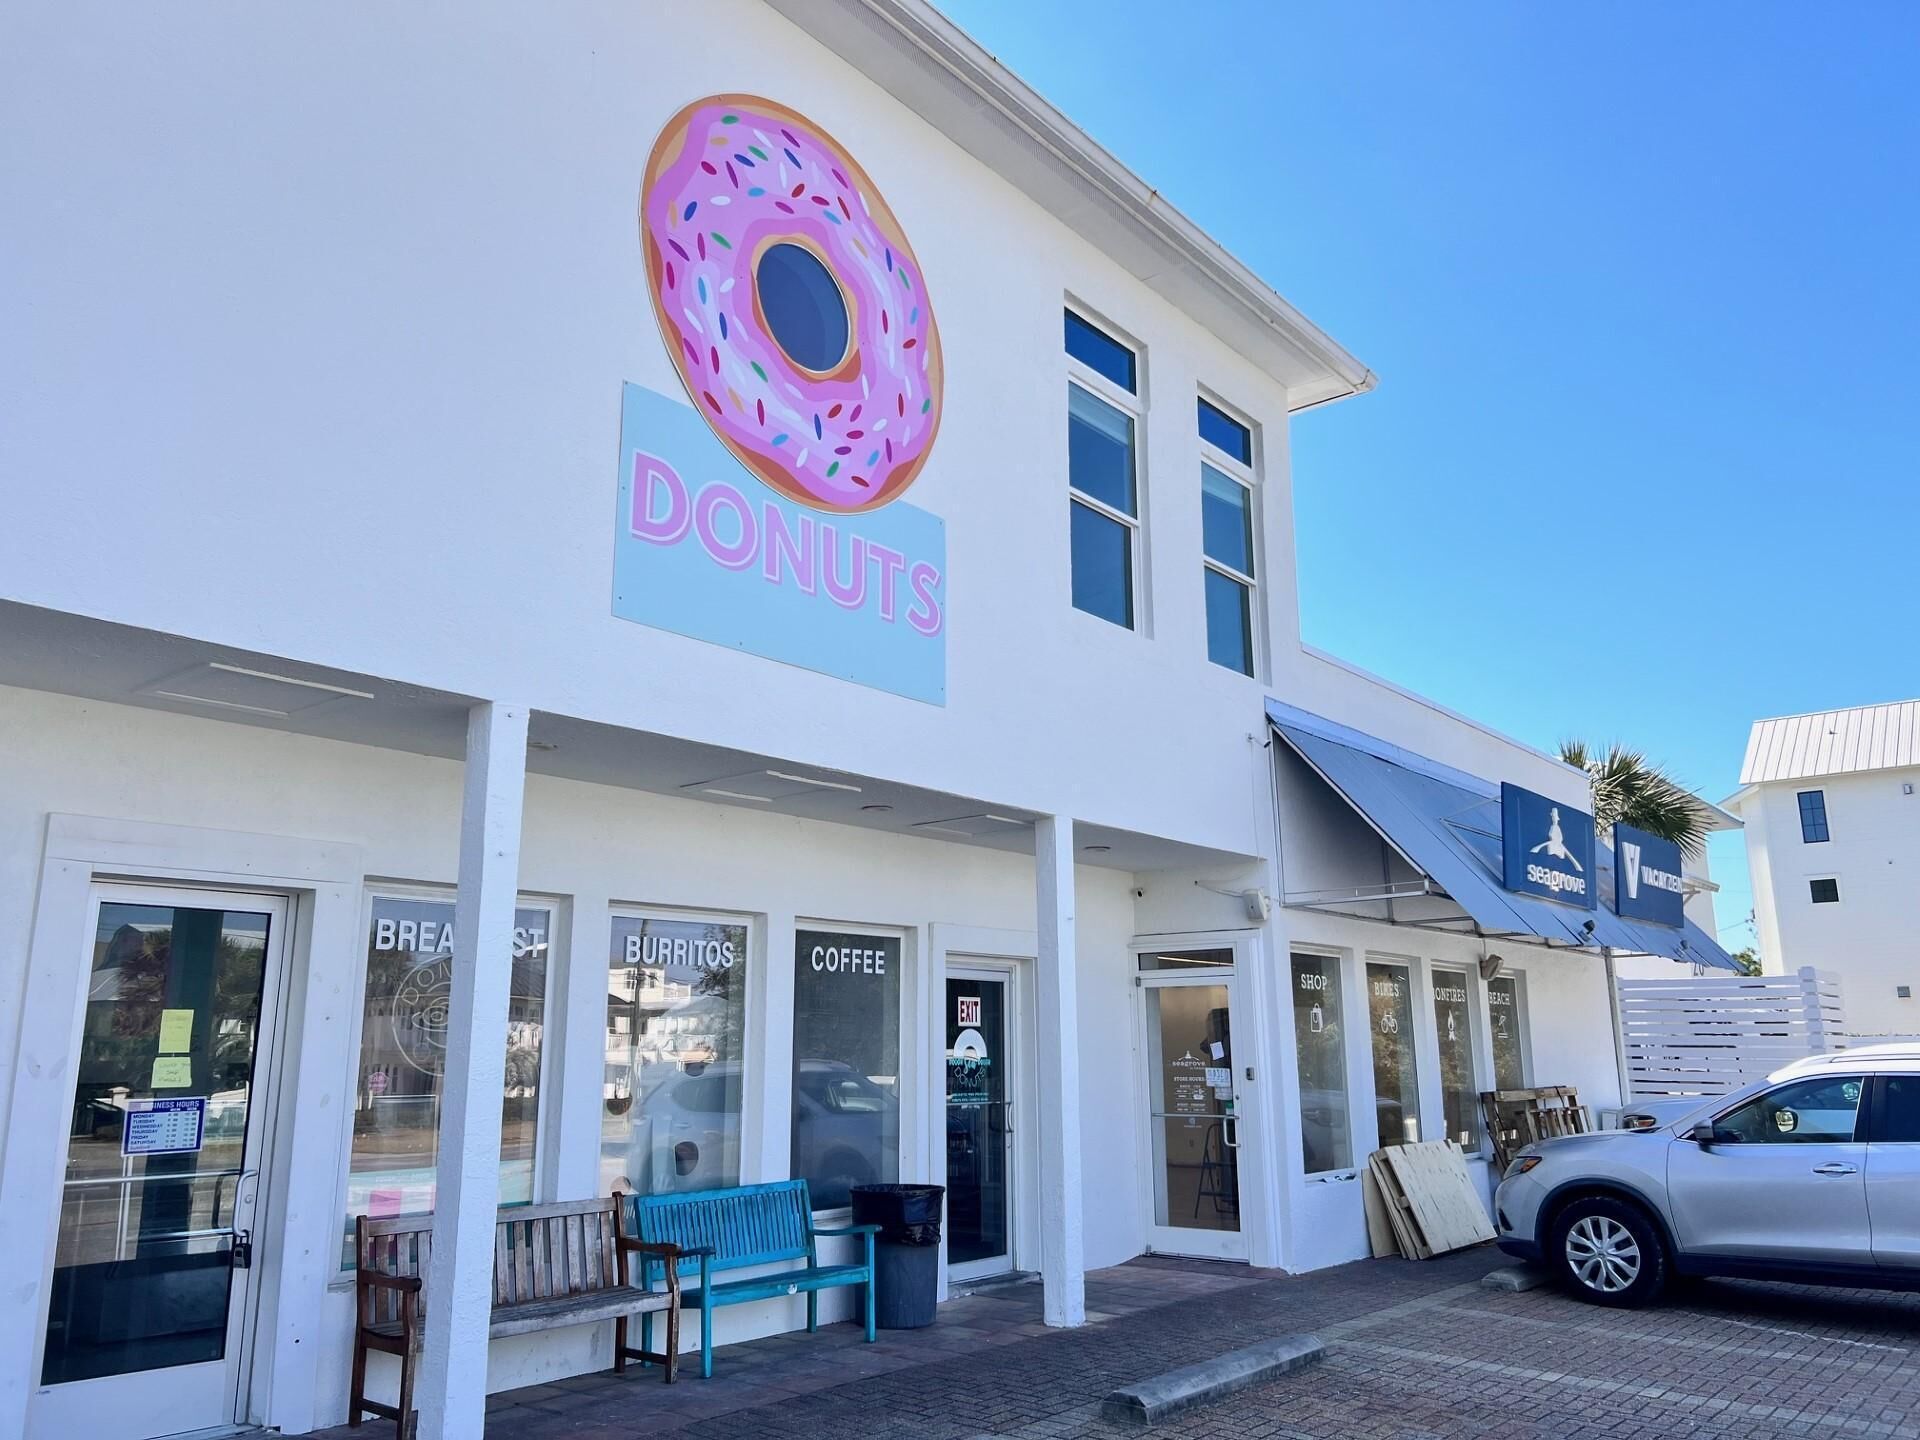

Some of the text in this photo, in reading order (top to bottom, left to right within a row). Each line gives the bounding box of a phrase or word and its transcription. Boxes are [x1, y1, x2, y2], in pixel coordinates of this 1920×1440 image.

[629, 448, 943, 637] DONUTS
[1526, 864, 1586, 895] seagrove
[1640, 865, 1683, 894] VACAYZEN
[374, 918, 546, 958] BREAST
[624, 935, 734, 968] BURRITOS
[811, 945, 885, 975] COFFEE
[1300, 973, 1328, 991] SHOP
[1374, 981, 1400, 997] BIKES
[959, 1000, 979, 1023] EXIT
[176, 1100, 200, 1108] HOURS
